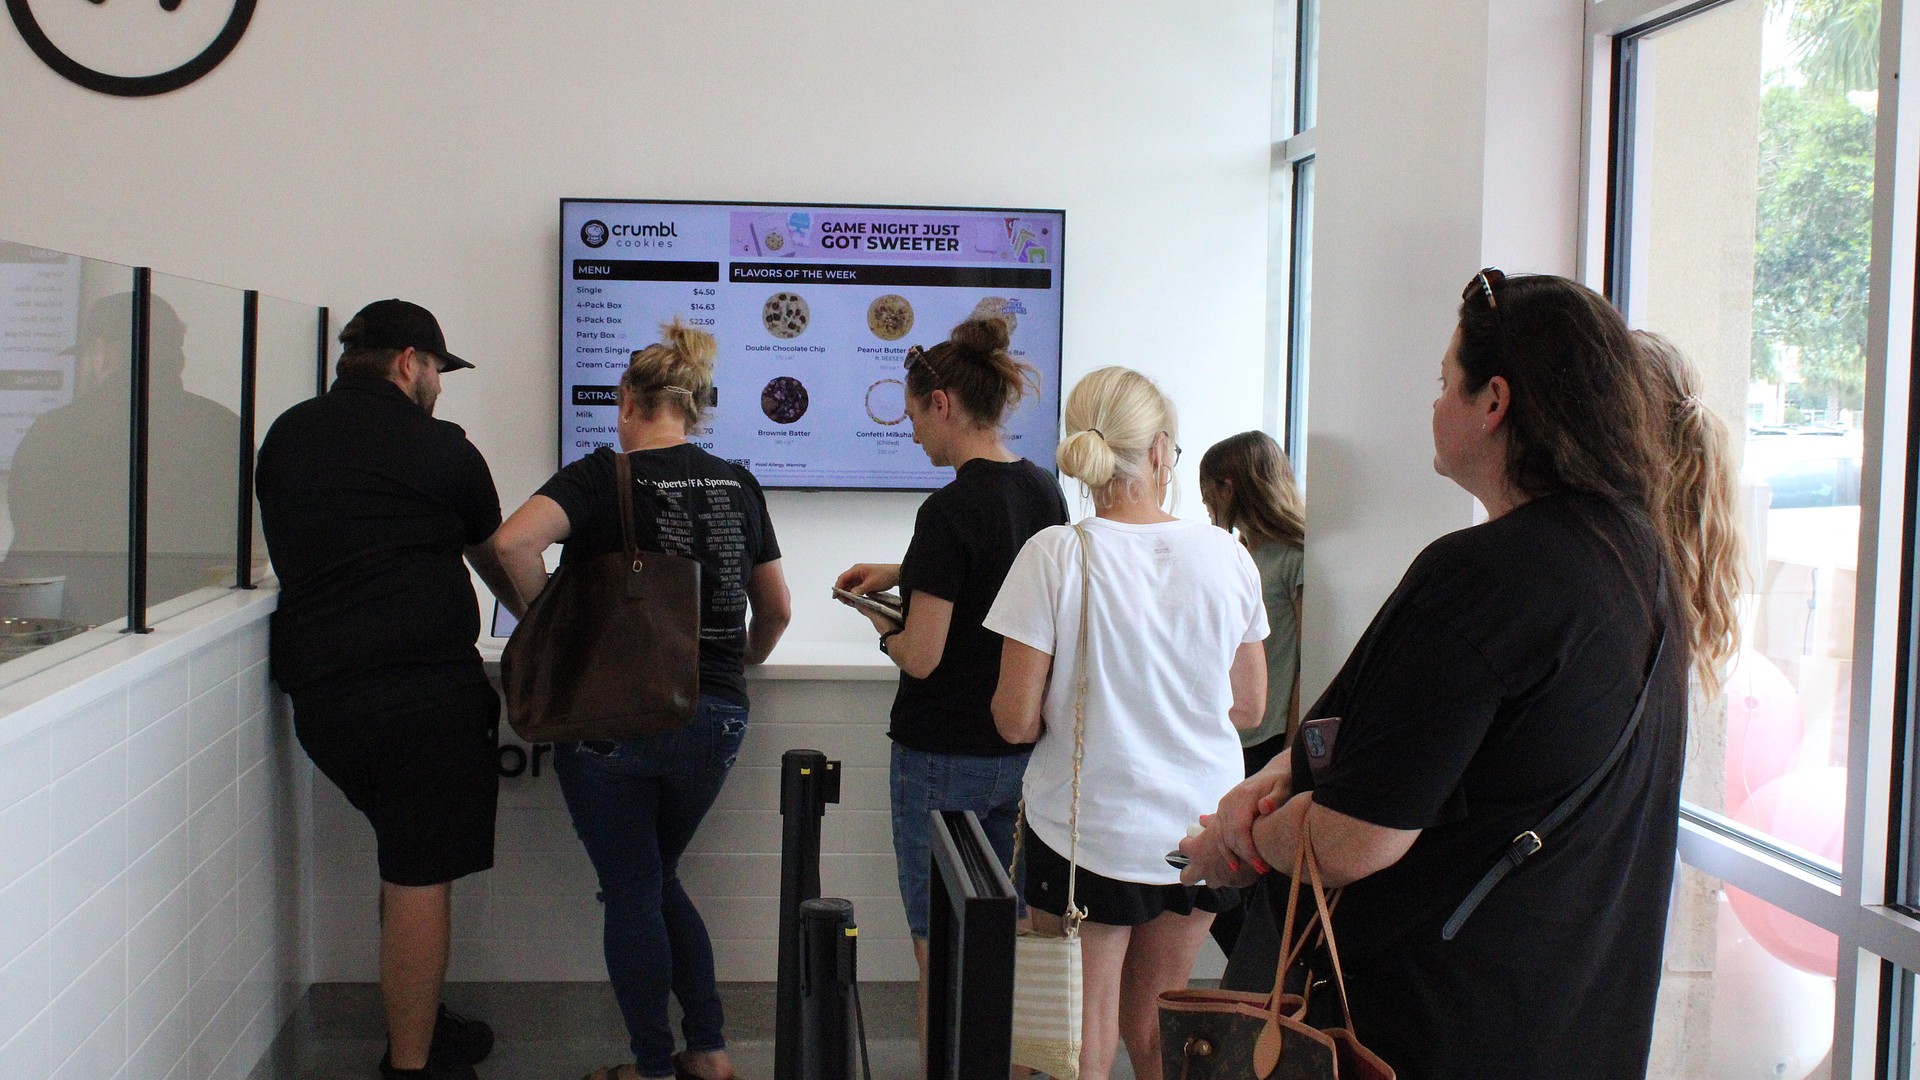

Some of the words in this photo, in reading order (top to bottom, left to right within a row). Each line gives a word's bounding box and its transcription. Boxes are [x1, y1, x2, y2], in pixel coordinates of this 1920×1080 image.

[612, 222, 678, 237] crumbl
[822, 222, 866, 234] GAME
[872, 223, 918, 234] NIGHT
[922, 224, 960, 236] JUST
[616, 238, 673, 248] cookies
[821, 236, 861, 250] GOT
[866, 236, 959, 252] SWEETER
[578, 266, 611, 275] MENU
[734, 268, 782, 278] FLAVORS
[784, 270, 800, 278] OF
[802, 270, 822, 278] THE
[825, 270, 857, 279] WEEK
[576, 286, 602, 294] Single
[693, 288, 716, 296] $4.50
[576, 302, 604, 310] 4-Pack
[690, 303, 716, 312] $14.63
[689, 318, 715, 326] $22.50
[576, 331, 598, 340] Party
[604, 346, 630, 356] Single
[576, 361, 603, 369] Cream
[604, 361, 629, 369] Carrie
[577, 391, 618, 400] EXTRAS
[593, 441, 614, 450] Wrap
[652, 479, 687, 489] oberts
